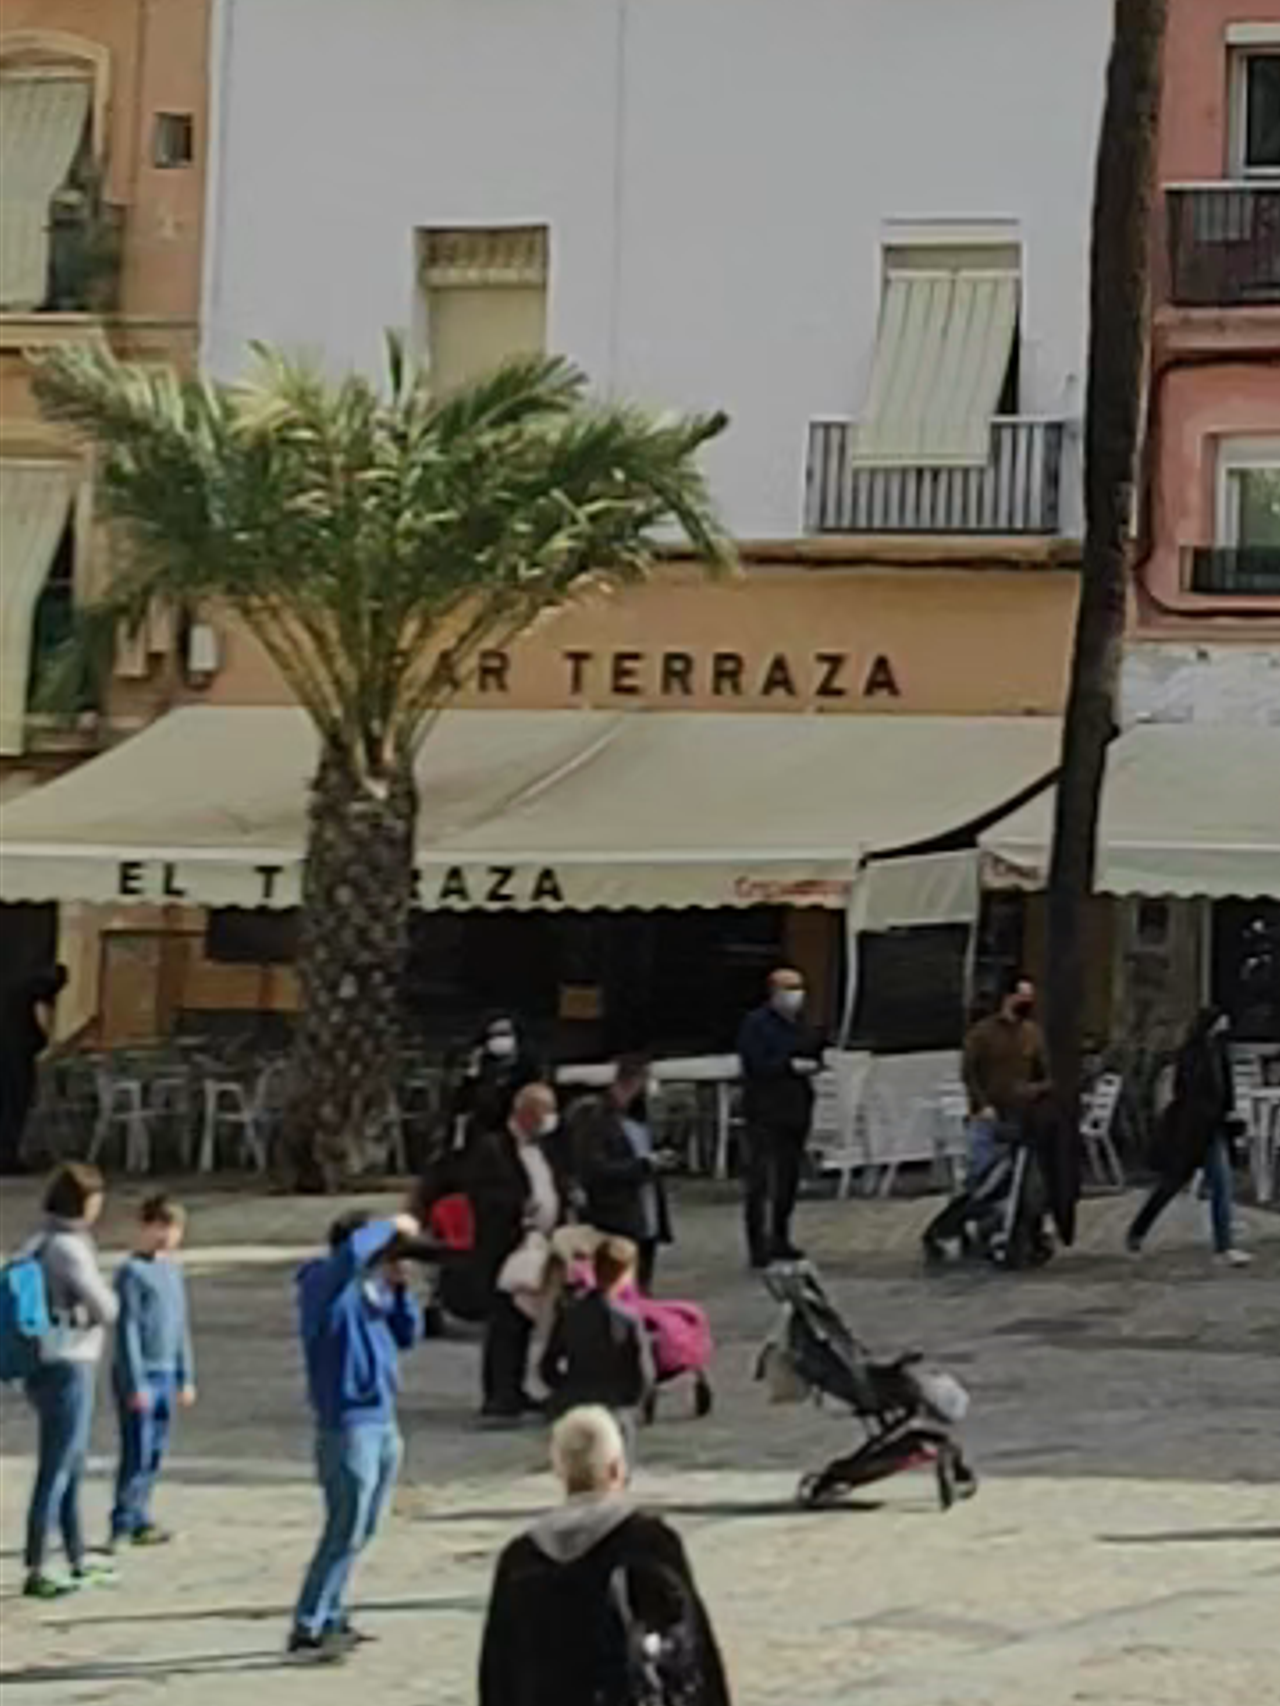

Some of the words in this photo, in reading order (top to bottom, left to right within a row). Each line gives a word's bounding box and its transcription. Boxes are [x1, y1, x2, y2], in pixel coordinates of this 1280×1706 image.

[563, 651, 901, 697] TERRAZA
[118, 861, 186, 897] EL
[254, 865, 564, 902] TAZA
